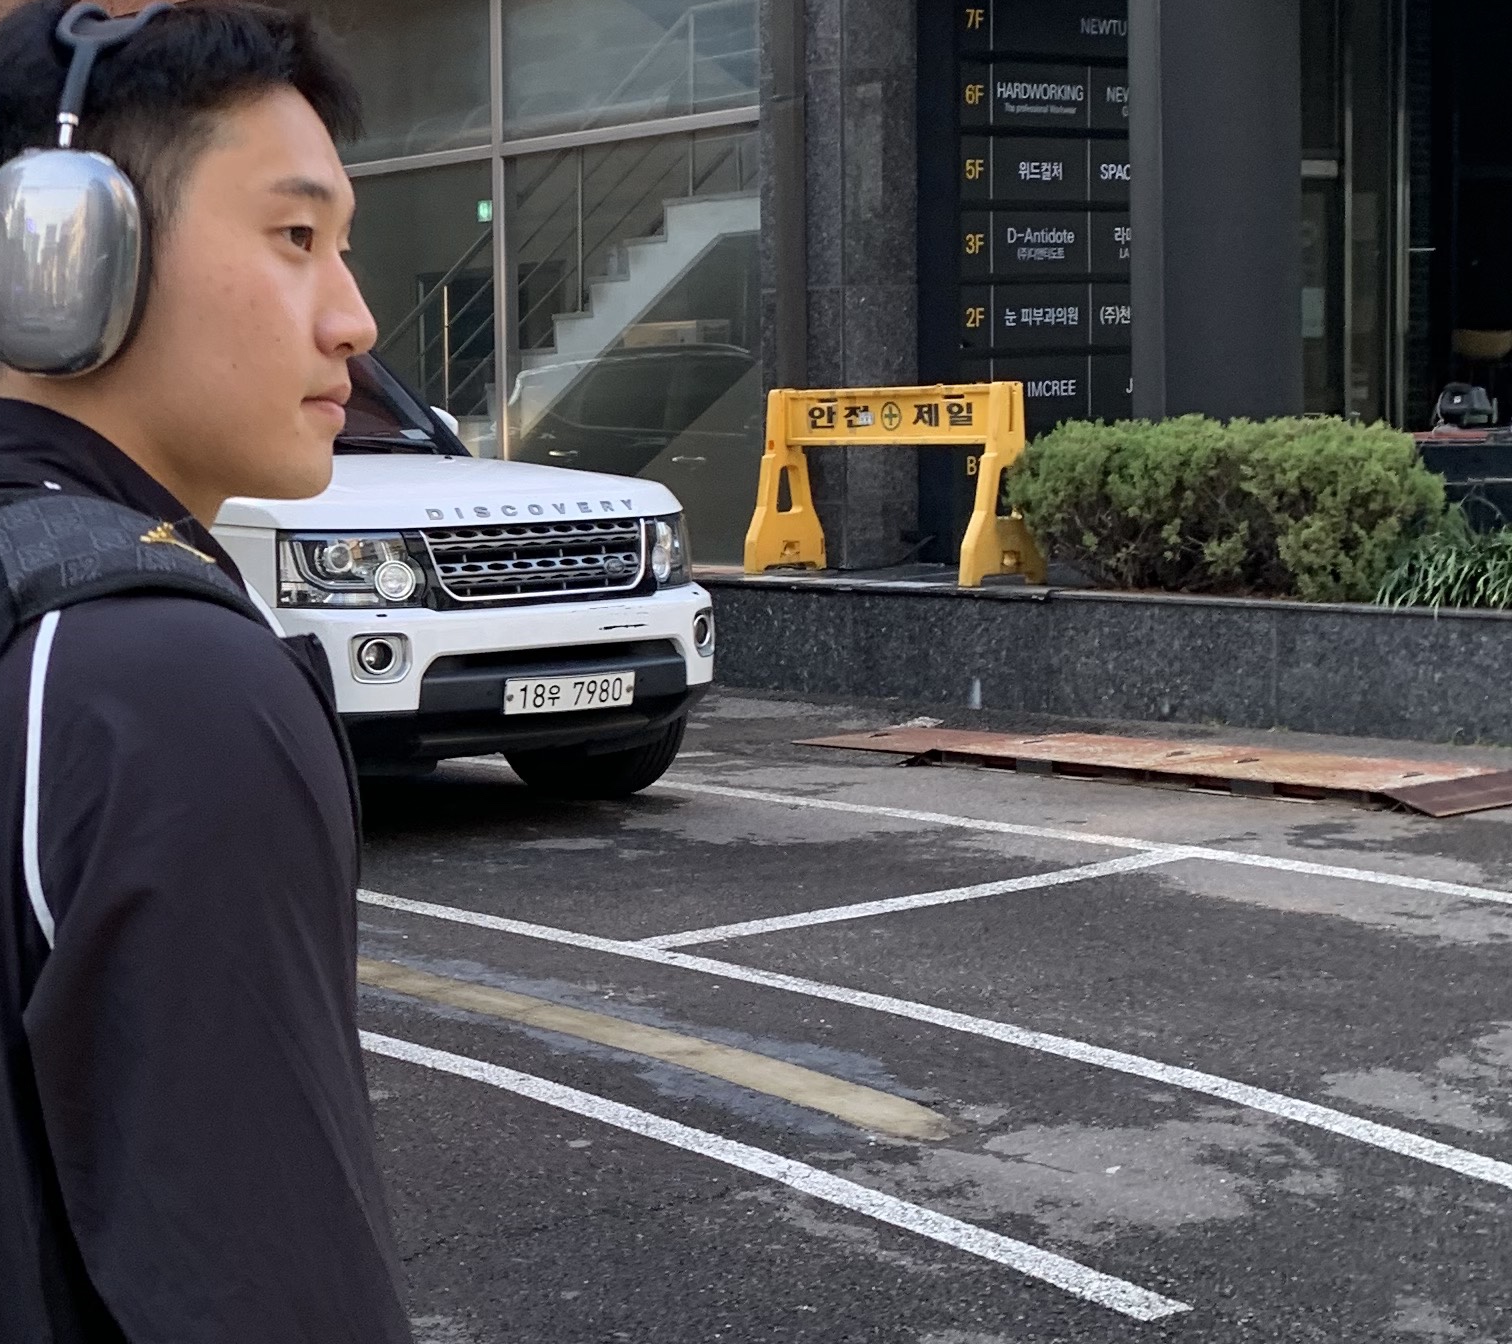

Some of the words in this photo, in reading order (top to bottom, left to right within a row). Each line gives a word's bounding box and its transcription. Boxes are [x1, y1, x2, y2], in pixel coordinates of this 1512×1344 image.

[967, 9, 984, 29] 7F
[966, 85, 984, 104] 6F
[997, 82, 1083, 101] HARDWORKING
[966, 159, 983, 179] 5F
[966, 234, 983, 254] 3F
[1008, 228, 1074, 243] D-Antidote
[967, 308, 984, 327] 2F
[1022, 308, 1078, 325] 피부과의원
[913, 402, 973, 428] 제일
[426, 499, 634, 521] DISCOVERY
[574, 678, 623, 706] 7980
